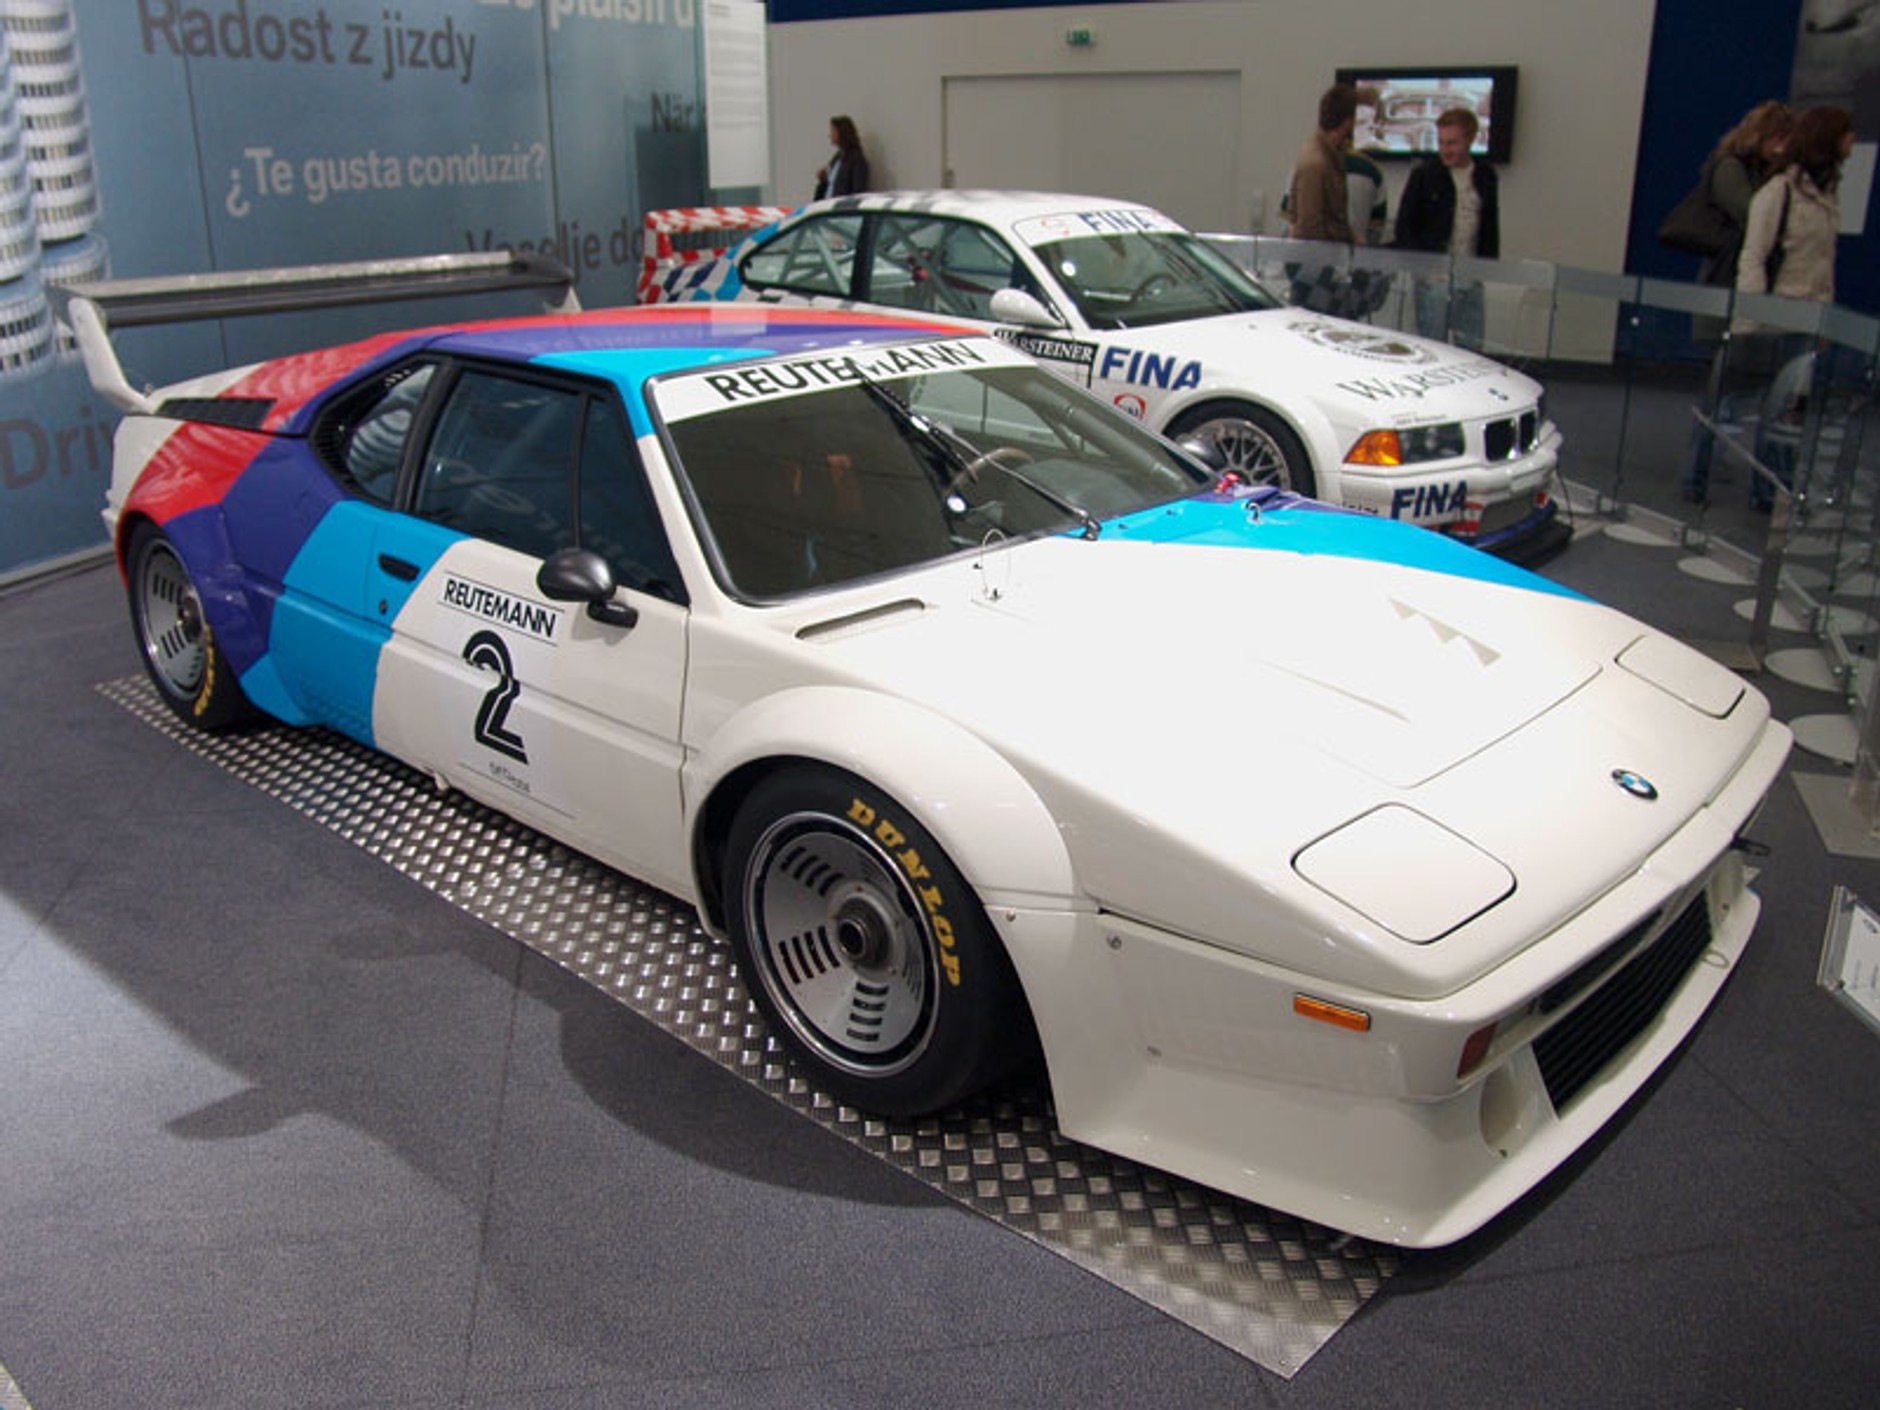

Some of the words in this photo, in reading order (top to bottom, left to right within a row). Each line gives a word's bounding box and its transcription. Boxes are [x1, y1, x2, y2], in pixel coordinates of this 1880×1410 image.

[136, 0, 336, 64] Radost
[346, 23, 373, 65] z
[382, 10, 476, 84] jizdy
[226, 147, 294, 218] ¿Te
[303, 150, 400, 204] gusta
[407, 142, 546, 188] conduzir?
[1101, 345, 1202, 391] FINA
[1391, 480, 1467, 520] FINA
[444, 578, 556, 638] REUTEMANN
[462, 629, 529, 766] 2
[846, 797, 960, 986] DUNLOP
